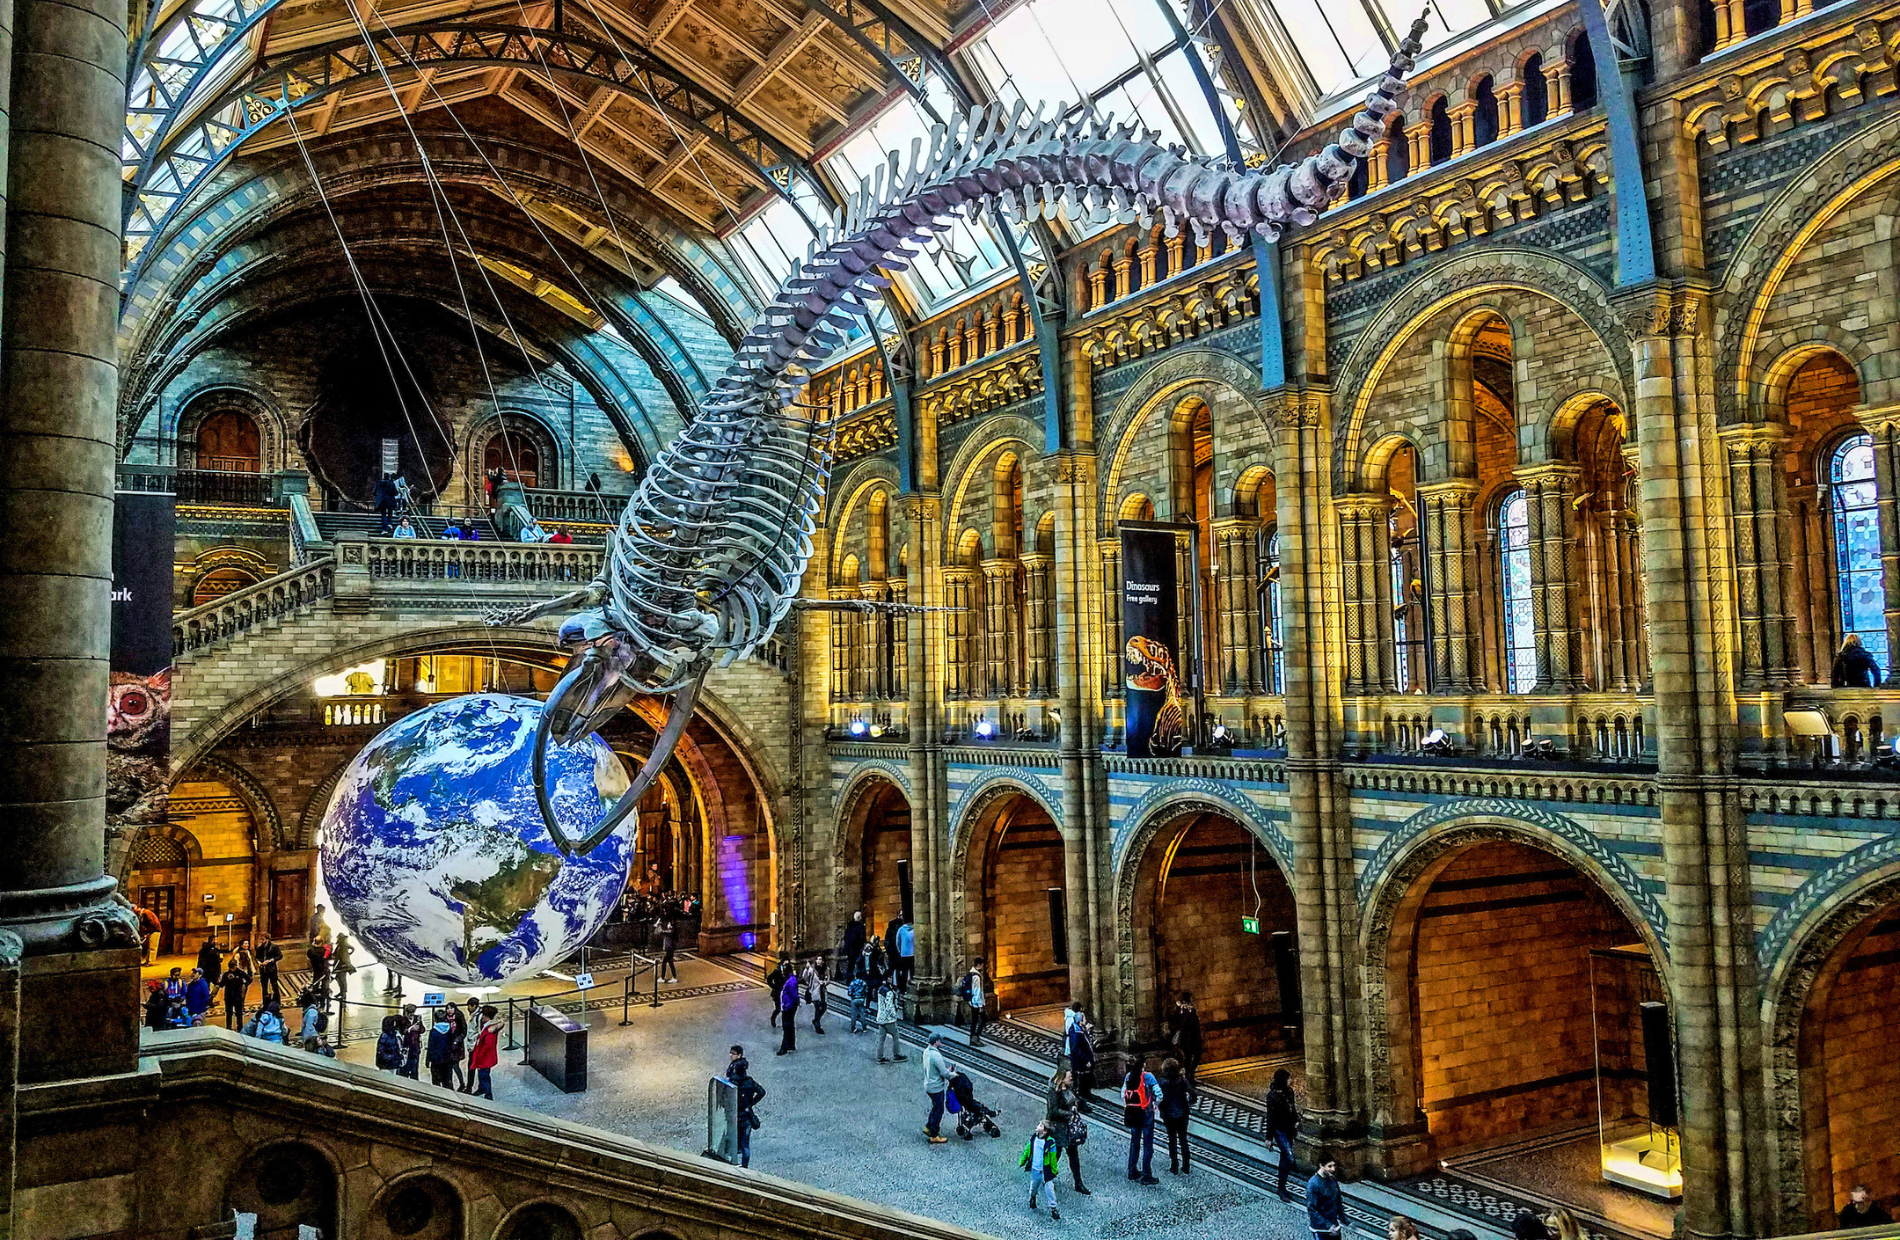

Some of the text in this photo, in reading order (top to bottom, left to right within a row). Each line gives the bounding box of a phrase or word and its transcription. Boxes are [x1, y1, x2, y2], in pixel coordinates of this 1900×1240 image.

[1126, 581, 1160, 591] Dinosaurs
[1126, 594, 1158, 604] Free gallery
